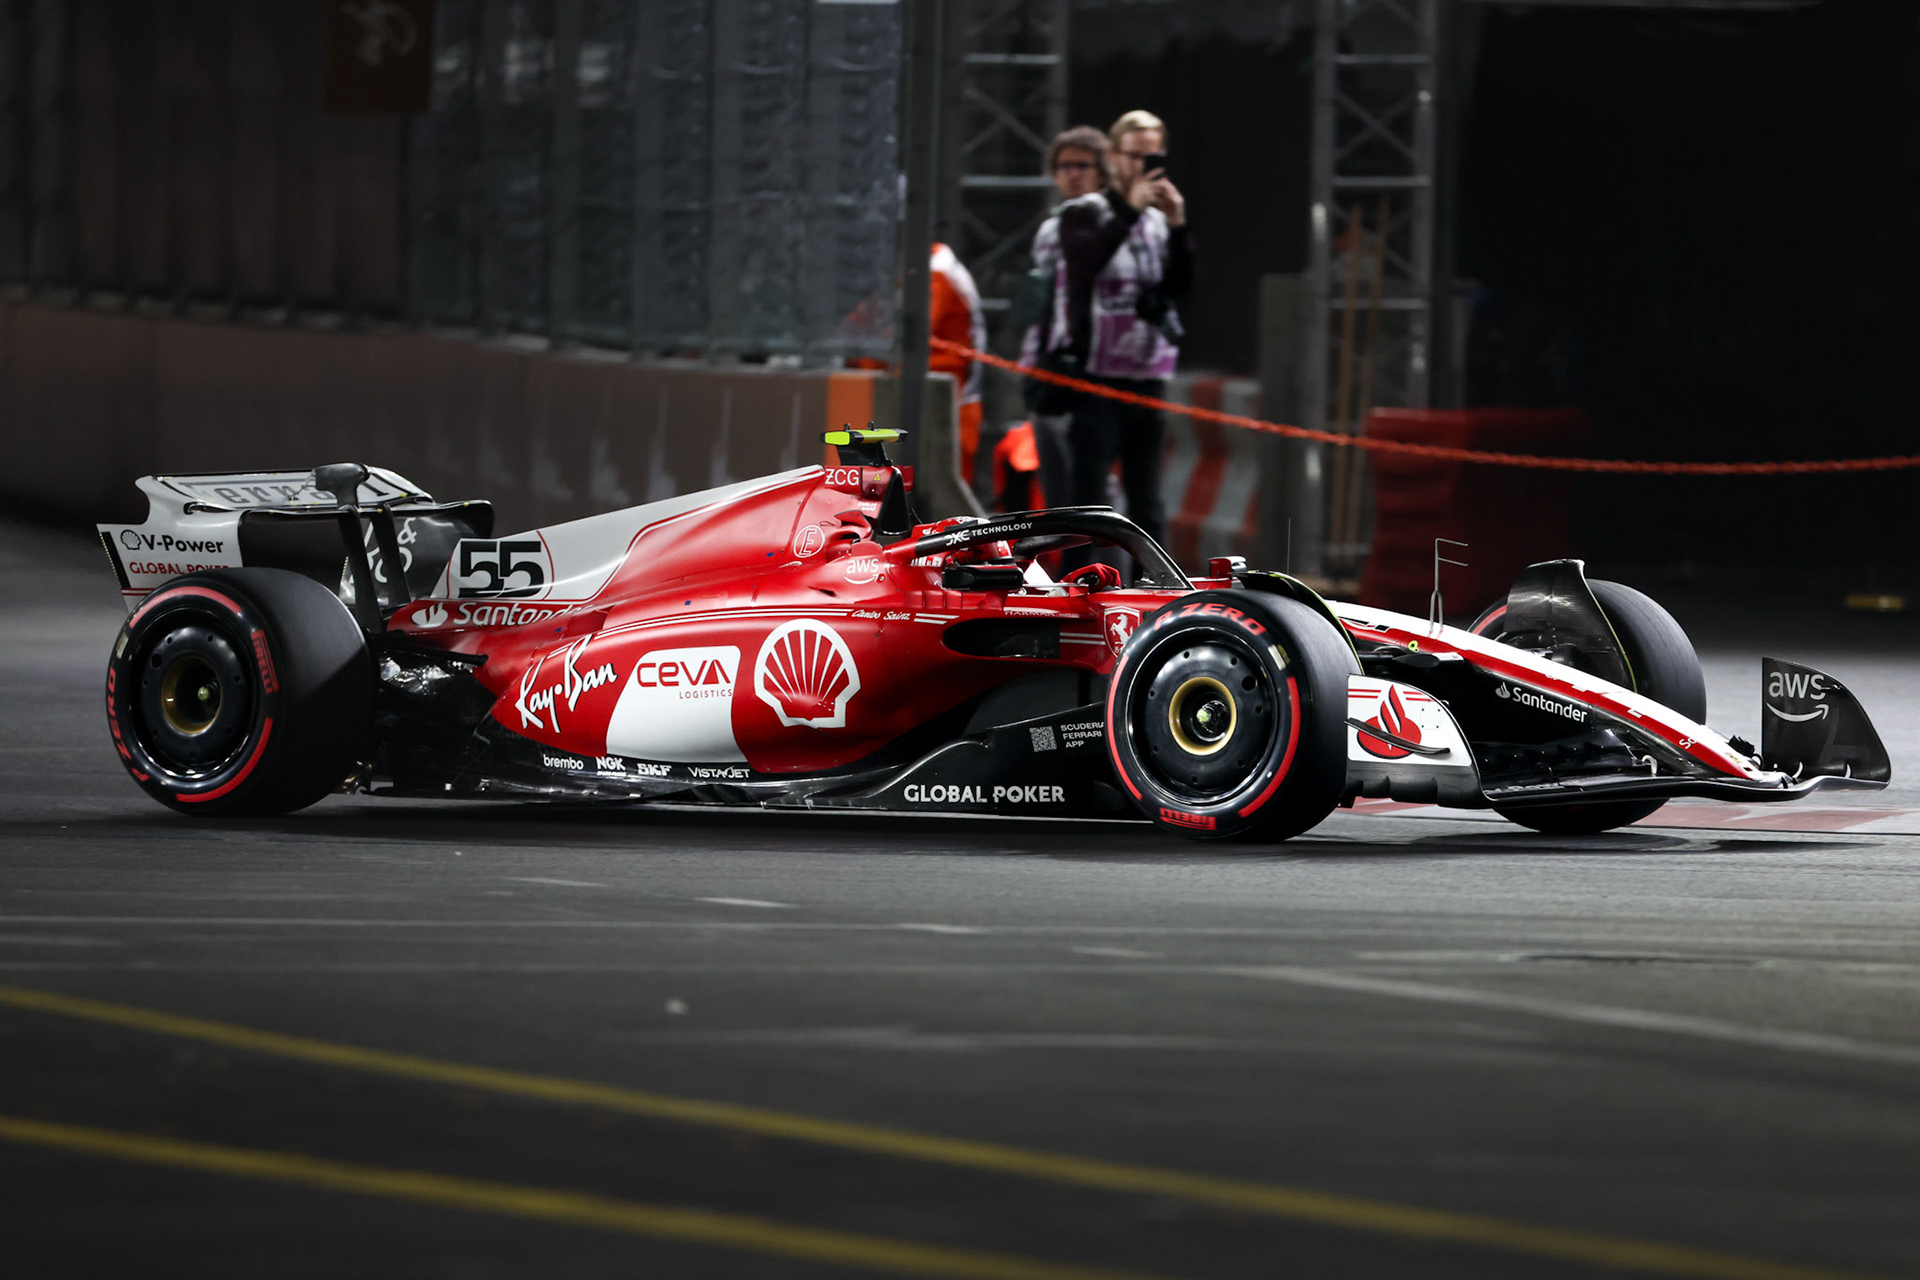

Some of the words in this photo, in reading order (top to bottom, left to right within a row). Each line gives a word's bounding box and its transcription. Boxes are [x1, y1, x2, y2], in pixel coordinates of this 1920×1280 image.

[824, 468, 860, 486] ZCG
[971, 522, 1033, 537] TECHNOLOGY
[141, 534, 224, 553] V-Power
[129, 561, 185, 575] GLOBAL
[458, 541, 545, 598] 55
[846, 558, 880, 575] aws
[851, 609, 881, 619] Carlos
[883, 610, 911, 621] Sainz
[1179, 602, 1268, 636] ZERO
[250, 629, 279, 695] PIRELLI
[679, 688, 733, 700] LOGISTICS
[1768, 671, 1826, 701] aws
[1512, 686, 1588, 723] Santander
[1062, 730, 1103, 740] FERRARI
[1065, 740, 1085, 749] APP
[543, 754, 585, 771] brembo
[595, 756, 627, 771] NGK
[637, 763, 673, 777] SKF
[903, 784, 988, 803] GLOBAL
[992, 786, 1066, 803] POKER
[1160, 807, 1217, 831] PIRELLI
